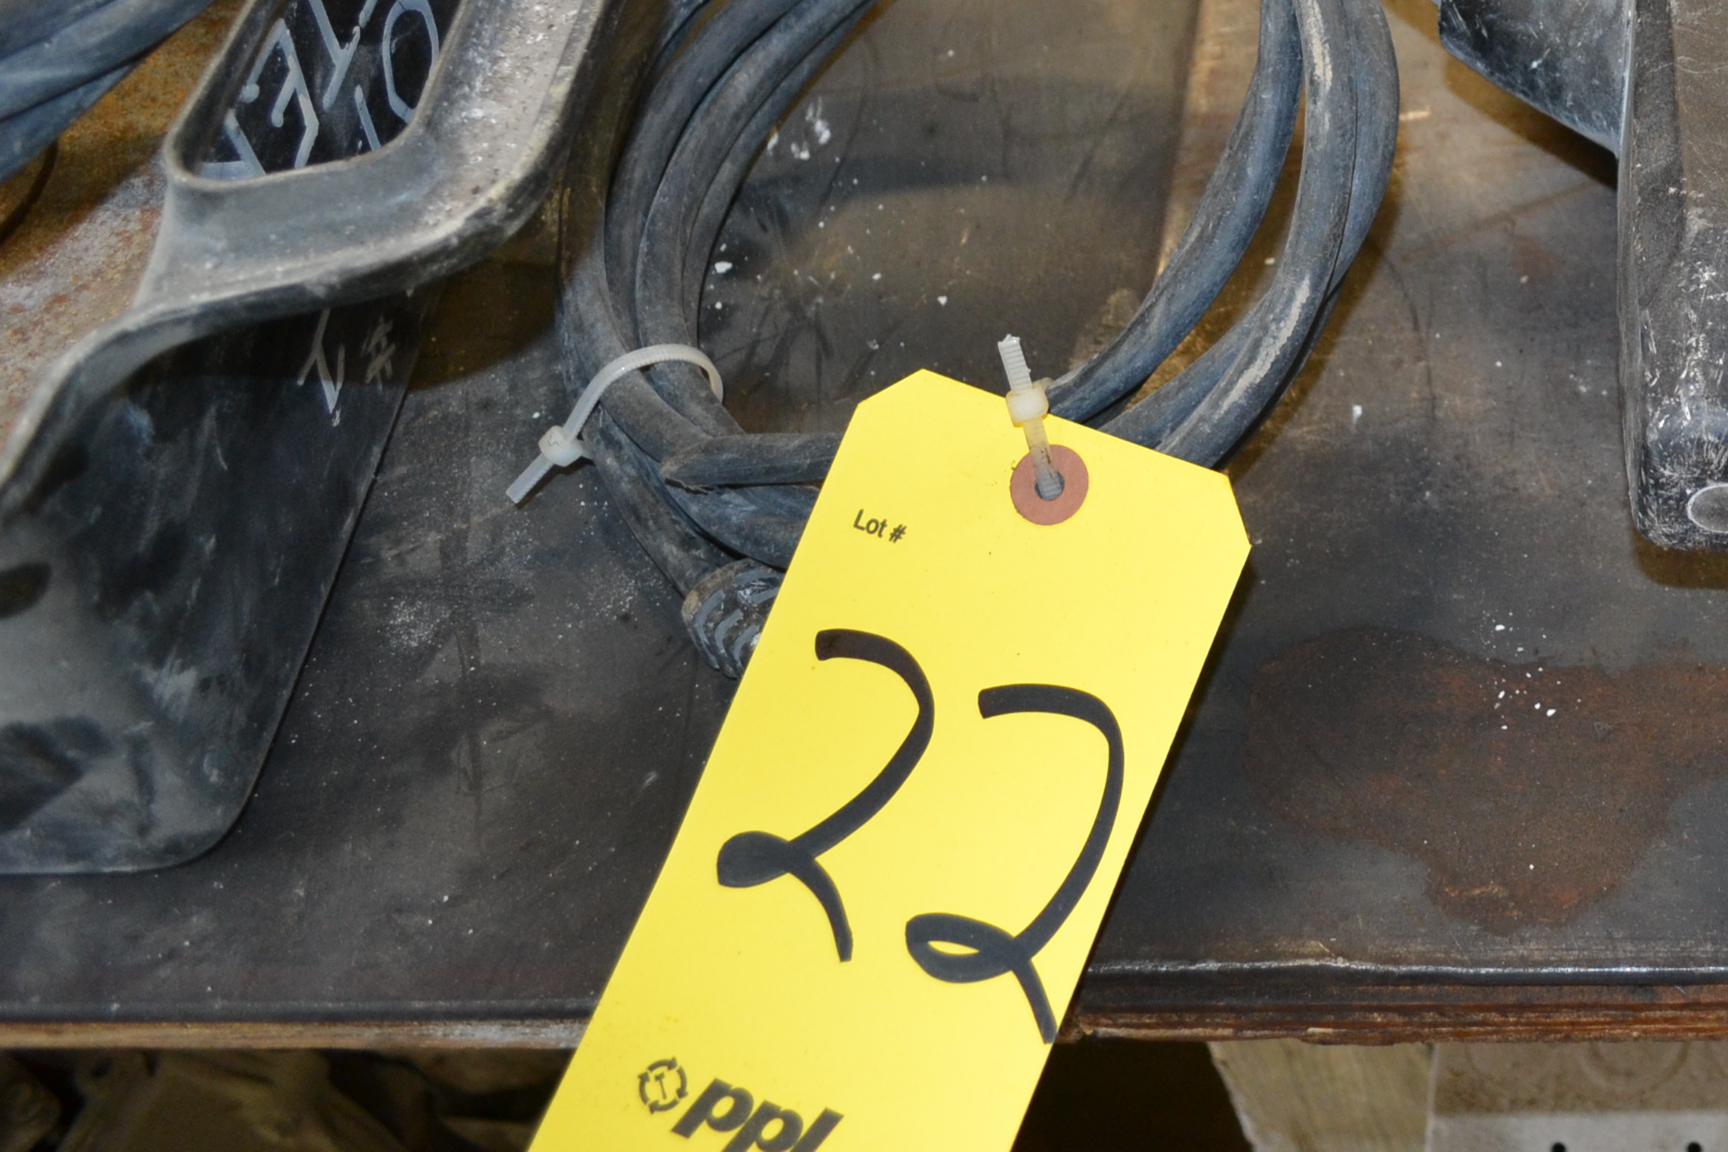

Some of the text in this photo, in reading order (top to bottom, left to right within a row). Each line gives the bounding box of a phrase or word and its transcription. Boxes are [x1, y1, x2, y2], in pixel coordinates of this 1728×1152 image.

[853, 508, 908, 544] Lot #
[716, 628, 1126, 1045] 22
[670, 1077, 845, 1152] ppl
